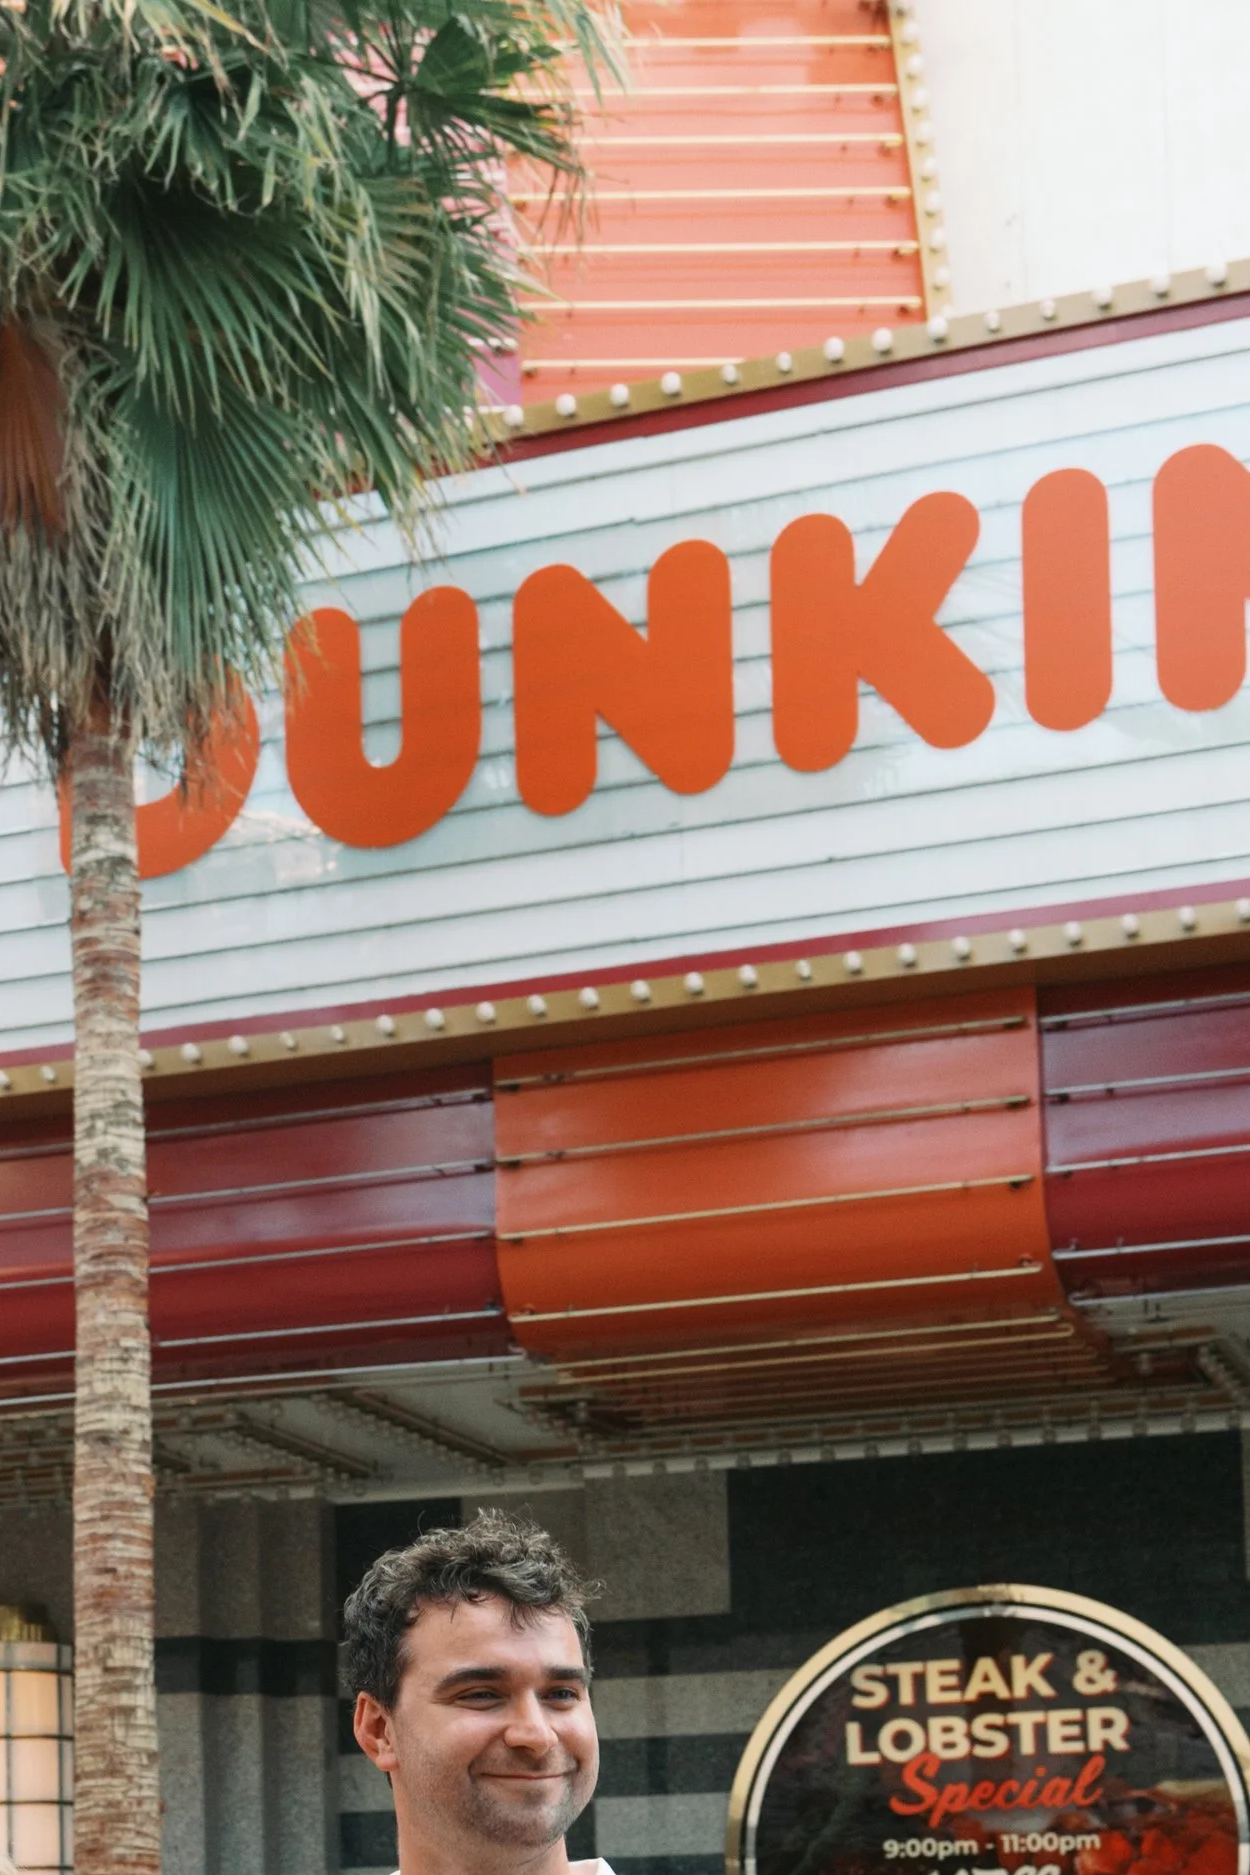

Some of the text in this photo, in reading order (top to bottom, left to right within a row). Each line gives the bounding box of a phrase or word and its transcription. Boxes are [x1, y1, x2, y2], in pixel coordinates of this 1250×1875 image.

[850, 1649, 1120, 1710] STEAK &
[845, 1706, 1131, 1766] LOBSTER
[889, 1752, 1107, 1829] Special
[882, 1837, 979, 1861] 9:00pm
[1000, 1832, 1101, 1856] 11:00pm
